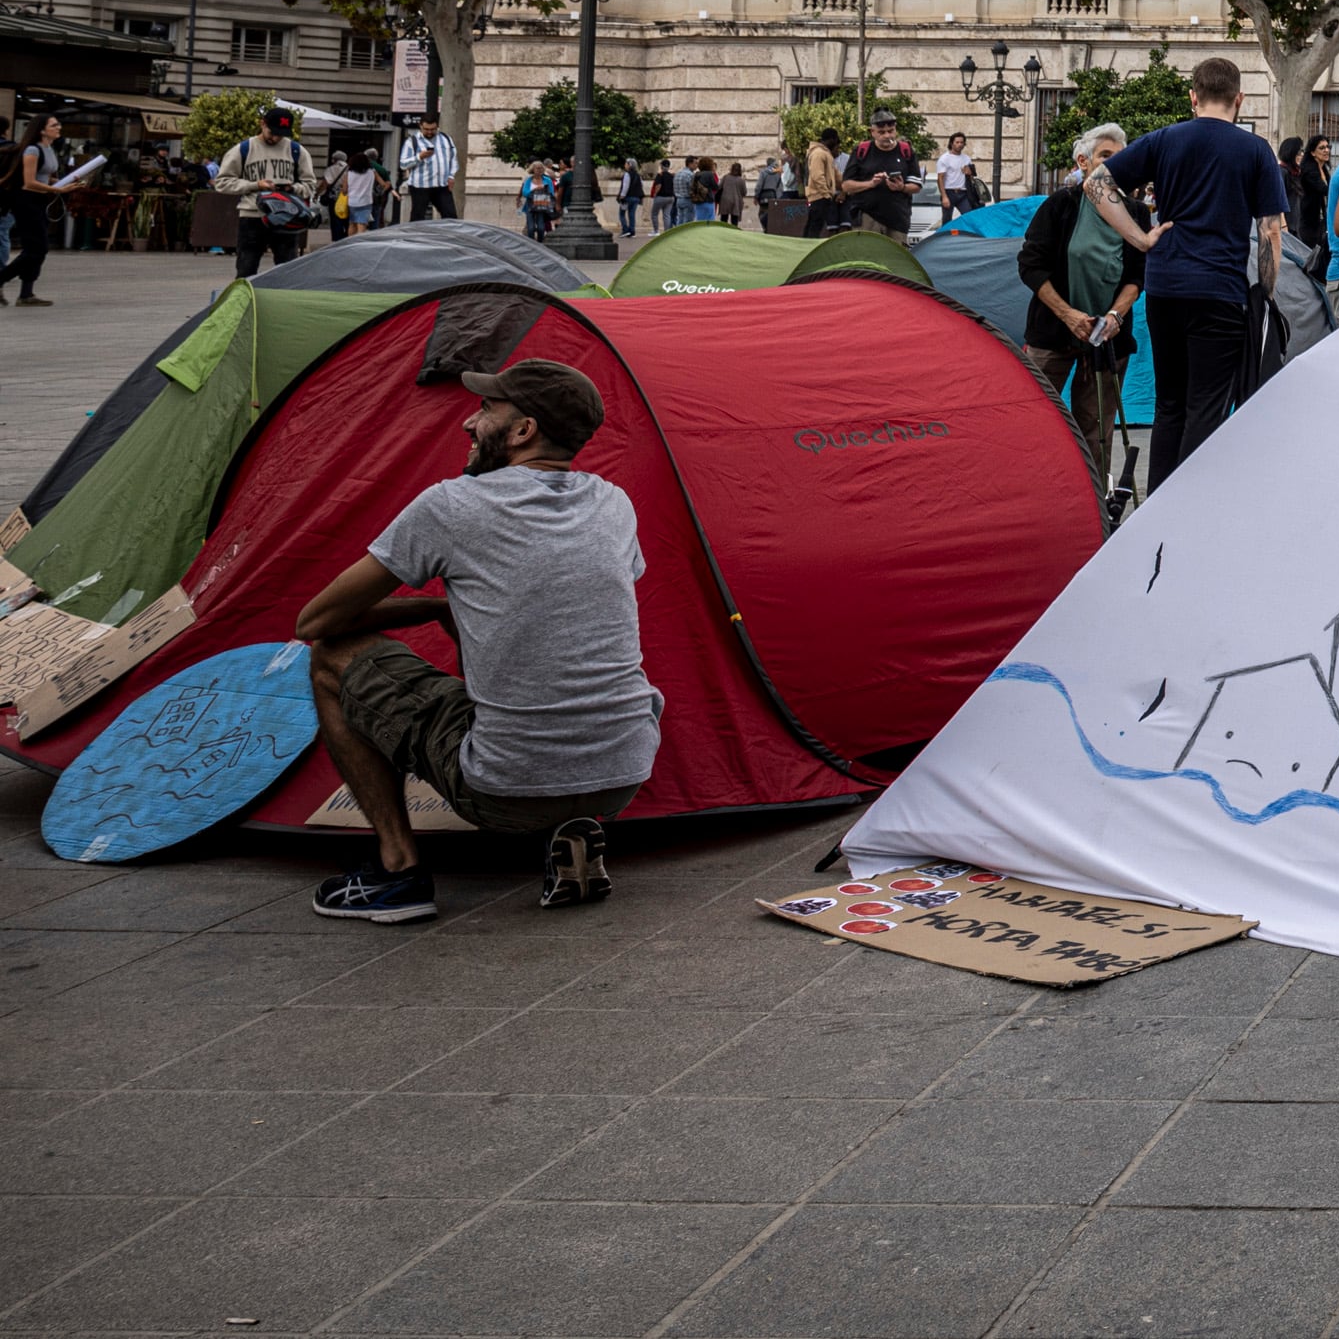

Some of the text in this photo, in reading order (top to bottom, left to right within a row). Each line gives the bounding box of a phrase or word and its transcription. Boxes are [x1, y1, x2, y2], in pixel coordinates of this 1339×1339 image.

[794, 421, 949, 454] Quechua
[902, 909, 1160, 973] HORTA, TAMBÉ
